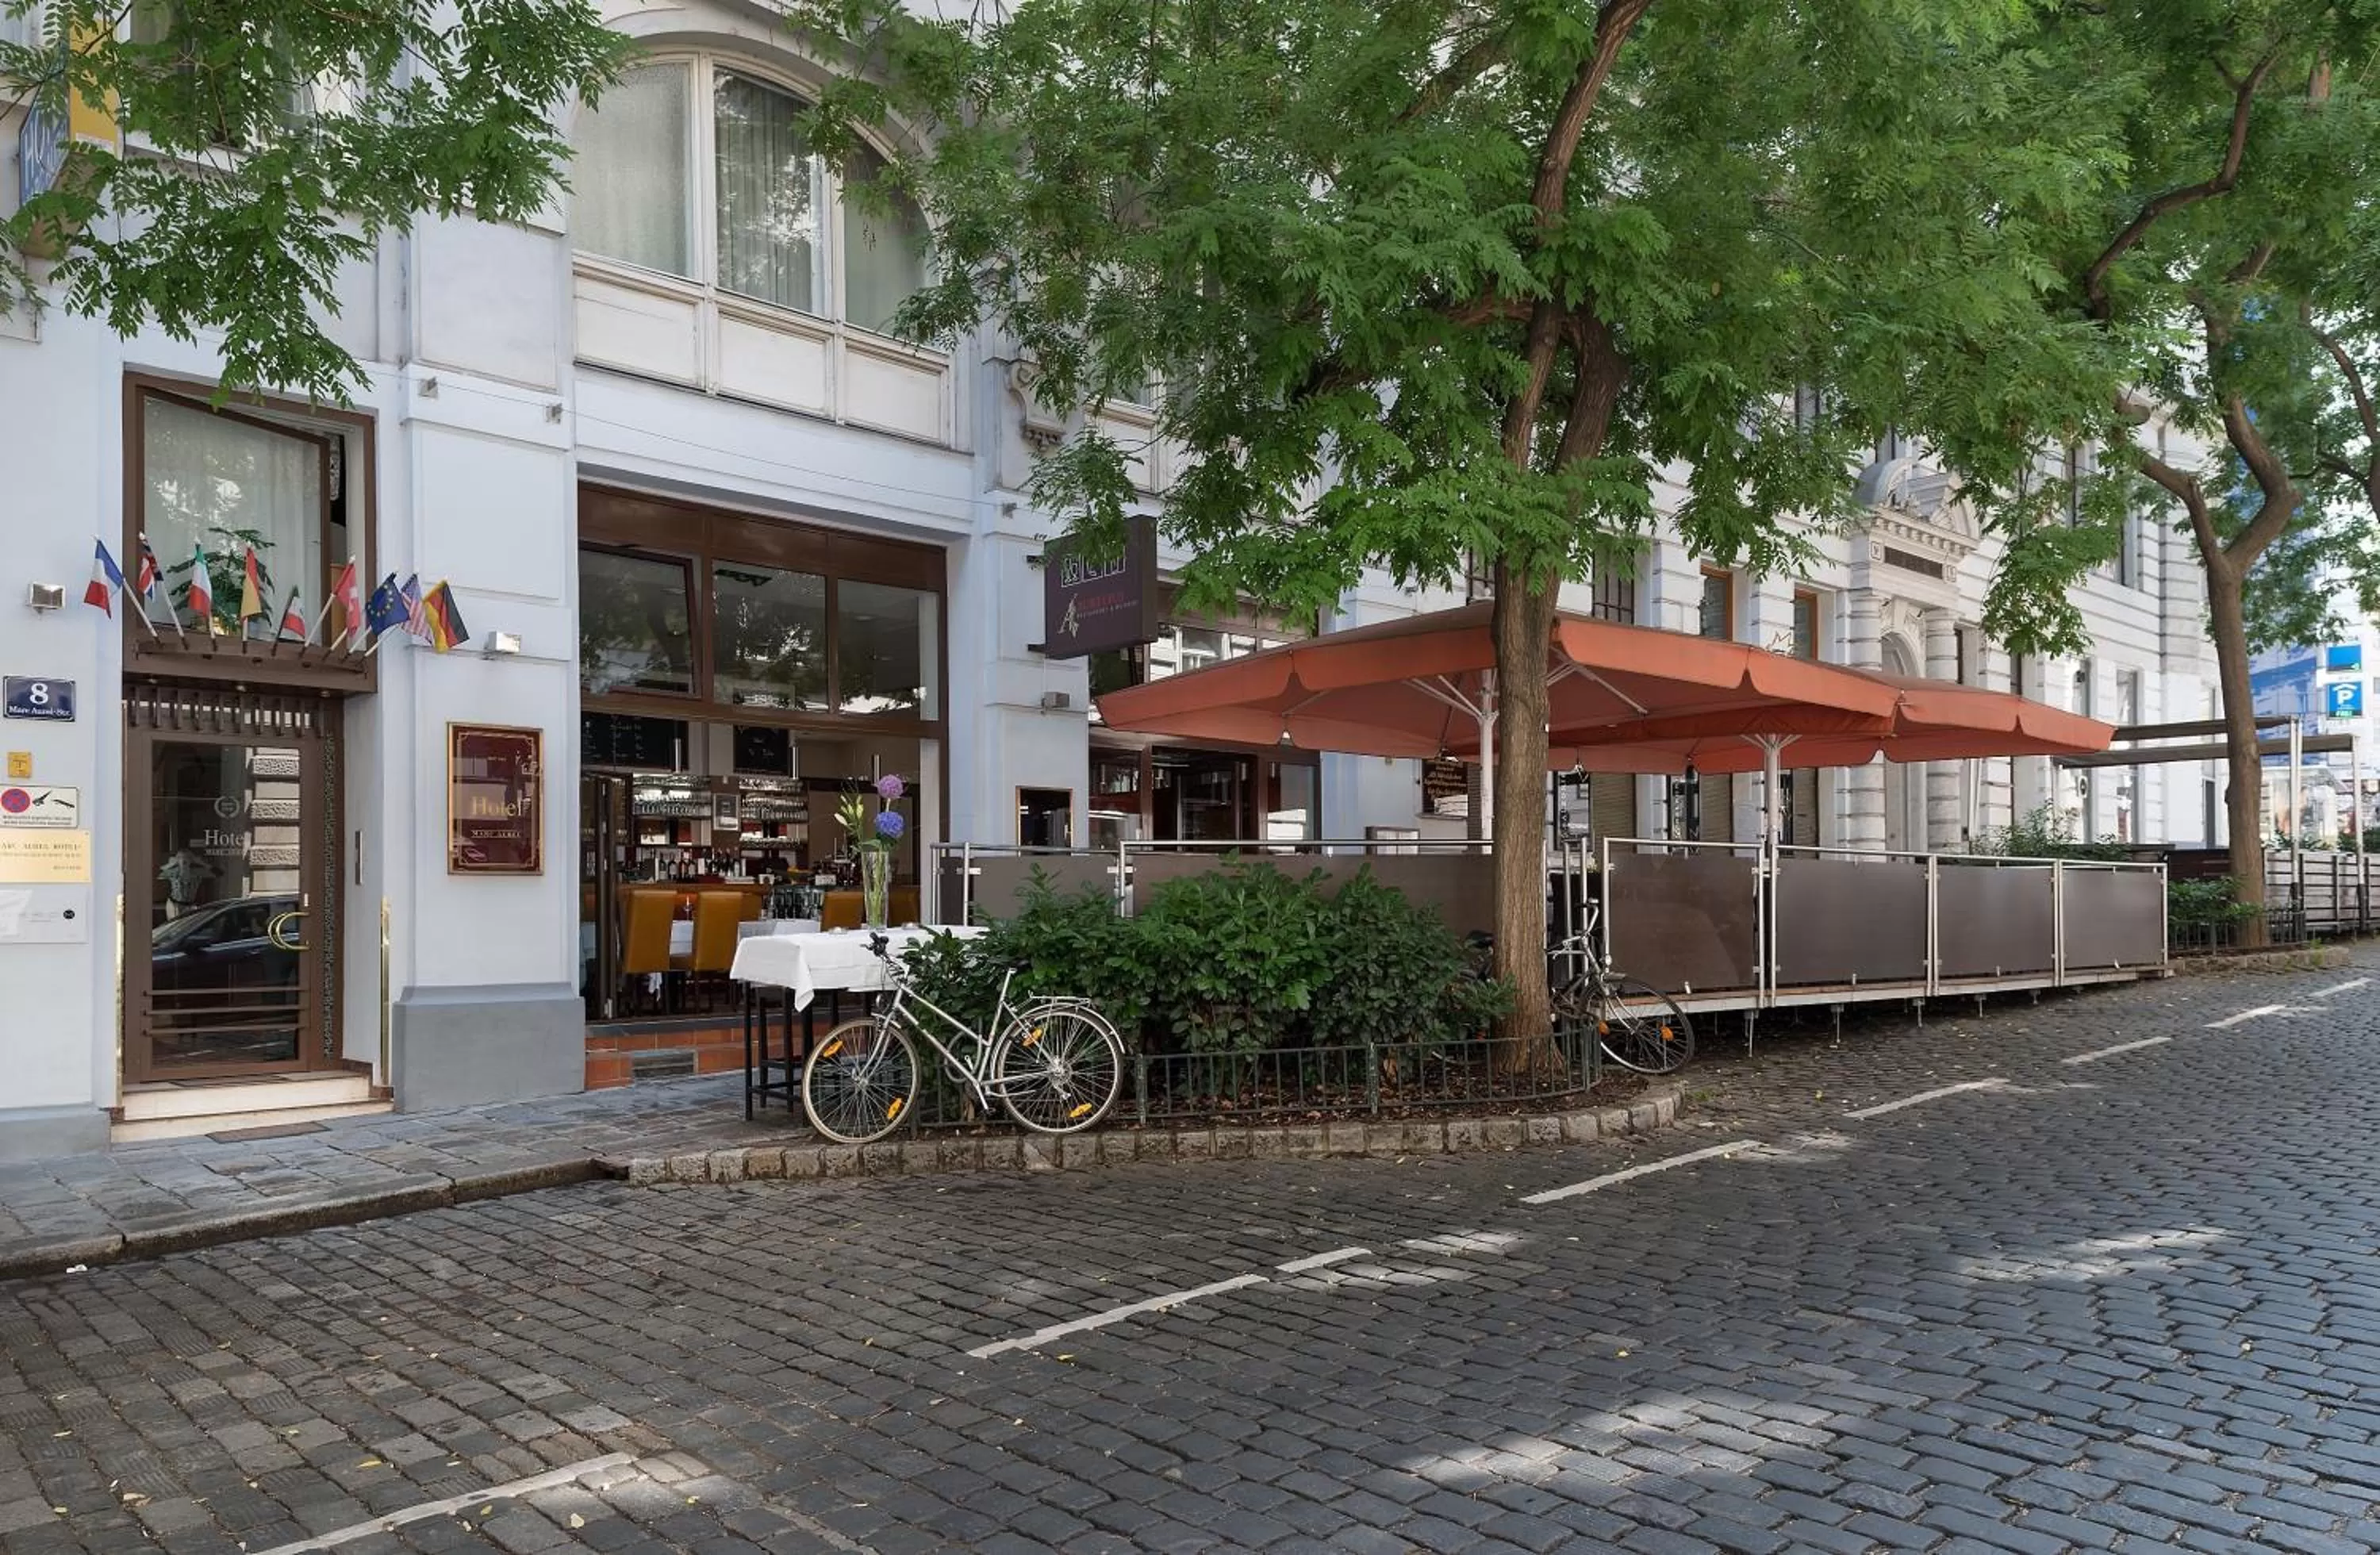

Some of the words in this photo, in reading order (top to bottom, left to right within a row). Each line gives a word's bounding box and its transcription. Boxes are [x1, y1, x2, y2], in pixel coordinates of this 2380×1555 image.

[29, 682, 48, 705] 8
[2336, 690, 2354, 704] P
[471, 796, 521, 816] Hotel
[204, 829, 245, 846] Hote
